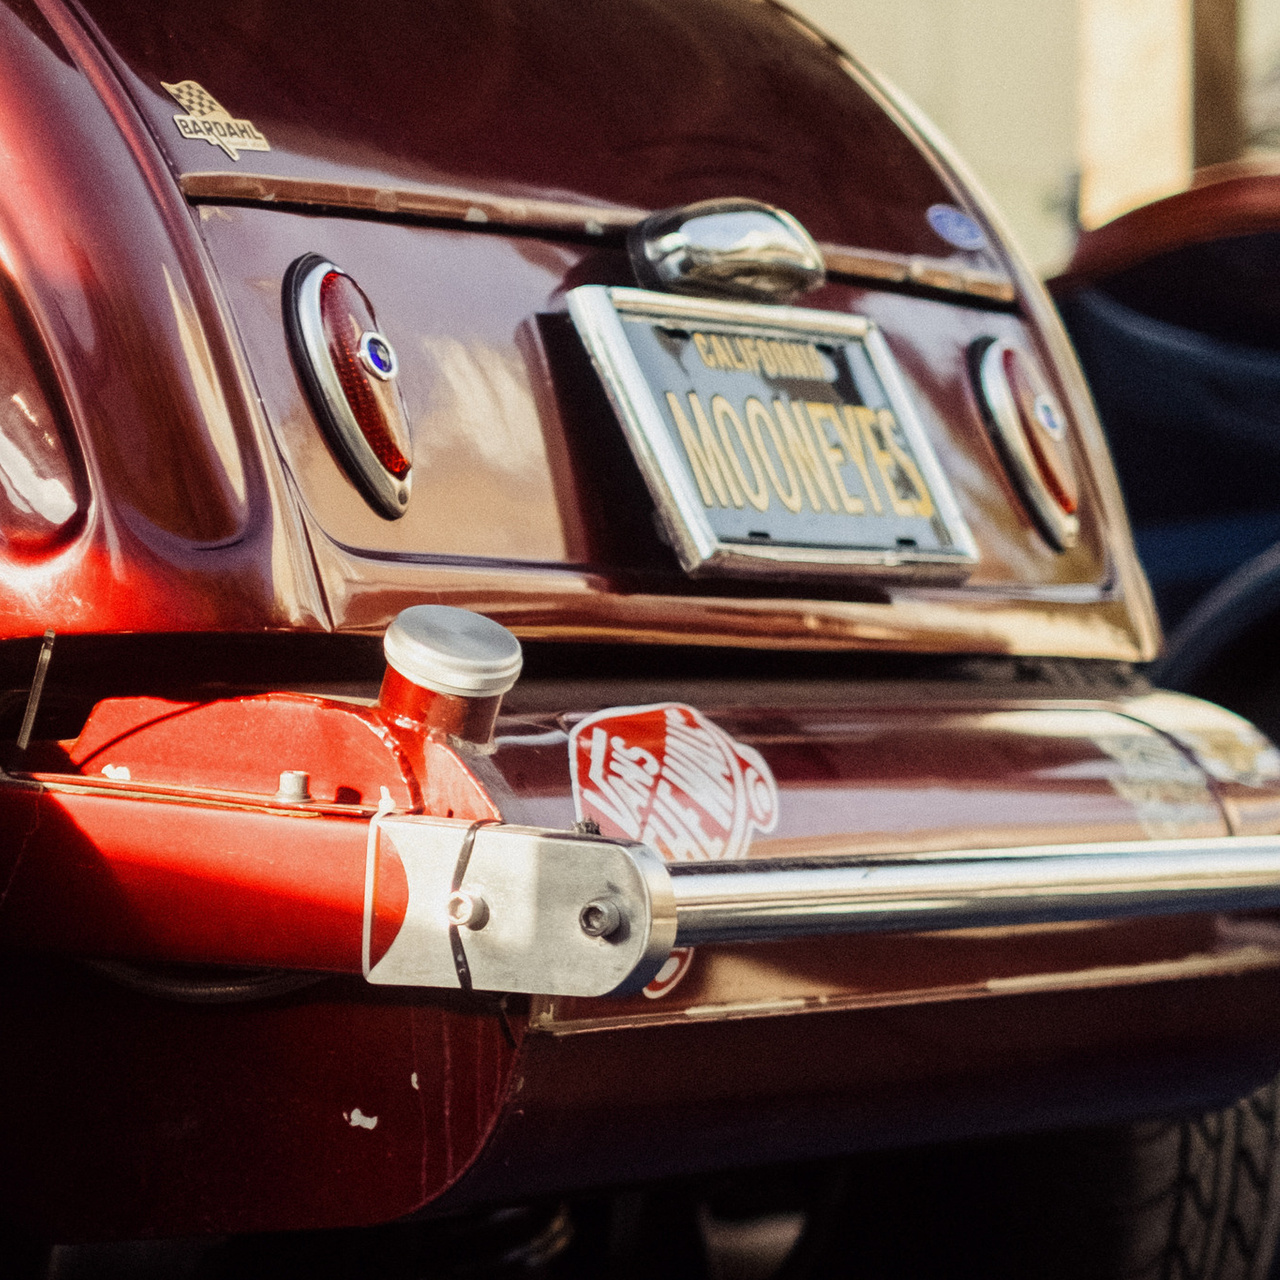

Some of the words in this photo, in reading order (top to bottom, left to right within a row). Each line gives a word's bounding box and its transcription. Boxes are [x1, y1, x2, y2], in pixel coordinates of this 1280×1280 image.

[177, 118, 263, 140] BARDAHL
[666, 391, 934, 518] MOONEYES
[583, 727, 660, 839] VANS
